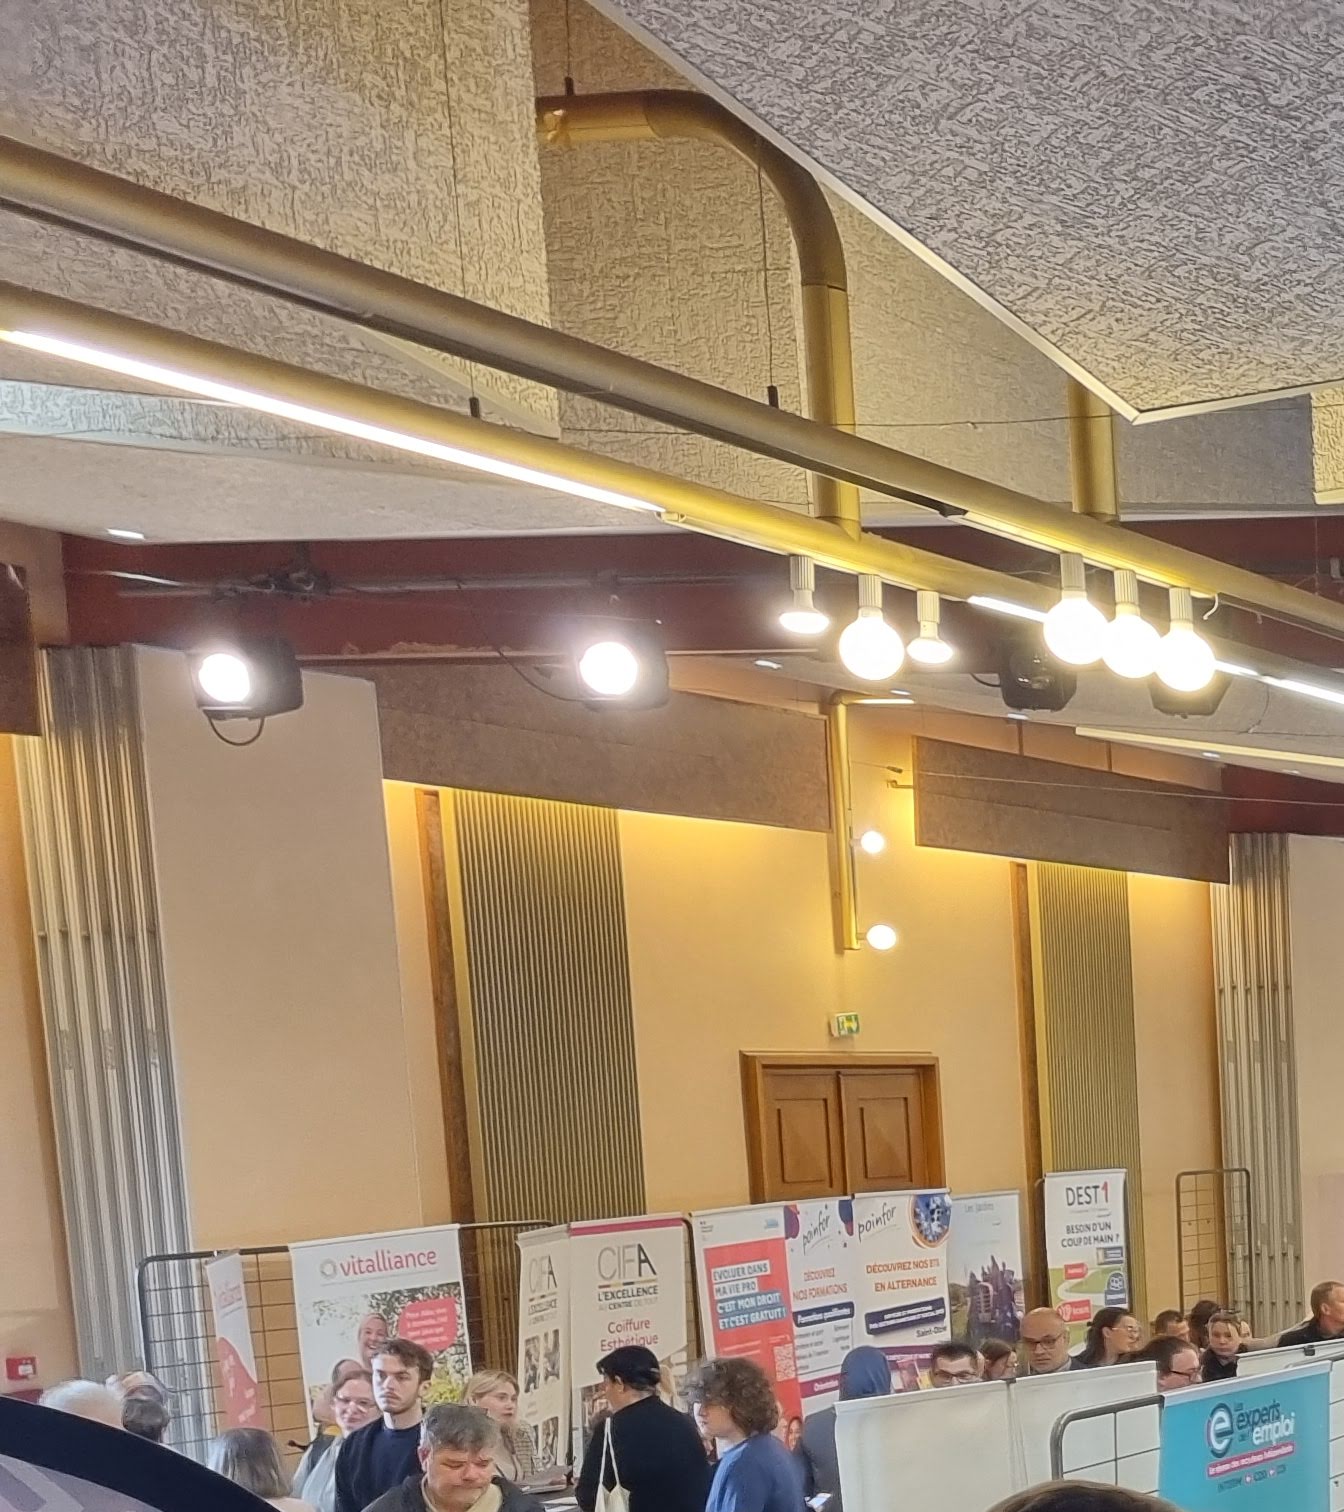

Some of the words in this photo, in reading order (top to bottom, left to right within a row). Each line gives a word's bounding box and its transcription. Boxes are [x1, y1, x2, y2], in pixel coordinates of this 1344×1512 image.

[858, 1202, 896, 1242] poinfor
[1066, 1223, 1091, 1234] BESOIN
[1061, 1236, 1082, 1248] COUP
[1084, 1236, 1092, 1245] DE
[1093, 1233, 1113, 1244] MAIN
[340, 1249, 438, 1277] vitalliance
[597, 1243, 658, 1281] CIFA
[747, 1262, 768, 1275] DANS
[866, 1258, 912, 1273] DÉCOUVREZ
[913, 1258, 929, 1269] NOS
[742, 1281, 756, 1293] PRO
[808, 1283, 848, 1298] FORMATIONS
[875, 1281, 885, 1292] EN
[887, 1276, 937, 1291] ALTERNANCE
[737, 1297, 756, 1309] MON
[757, 1292, 780, 1305] DROIT
[750, 1307, 782, 1323] GRATUIT
[607, 1317, 652, 1334] Coiffure
[1253, 1412, 1295, 1446] emploi
